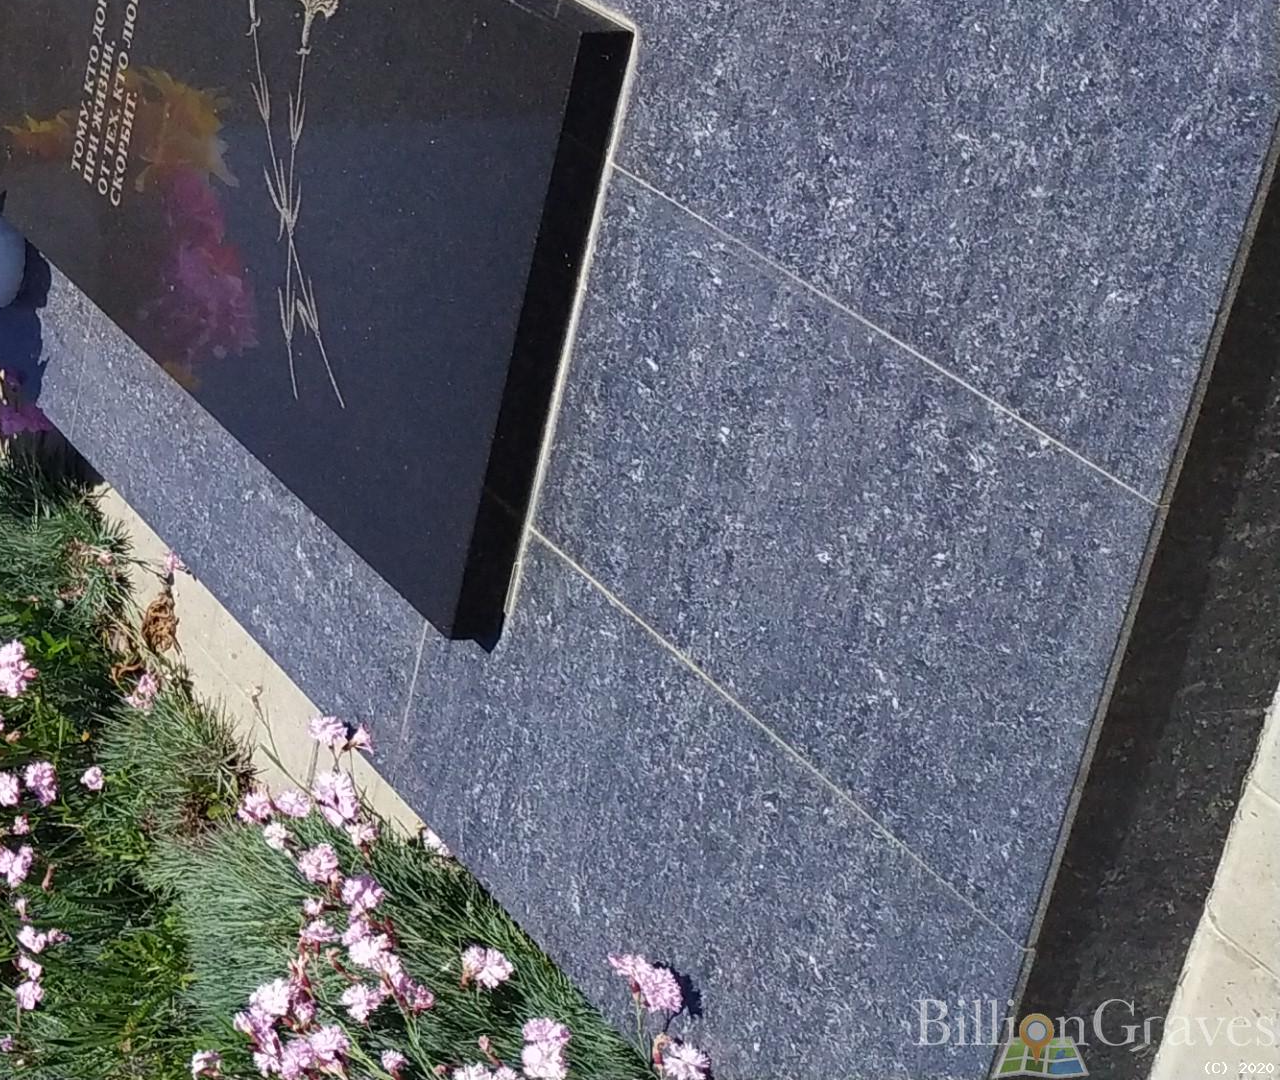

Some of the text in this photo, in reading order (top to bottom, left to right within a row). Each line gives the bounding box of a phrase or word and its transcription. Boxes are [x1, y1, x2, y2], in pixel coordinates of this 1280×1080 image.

[112, 51, 129, 101] КТО
[71, 99, 93, 171] ТОМУ,
[84, 45, 100, 94] КТО
[104, 107, 121, 156] ТЕХ,
[83, 135, 100, 184] ПРИ
[110, 92, 138, 207] СКОРБИТ.
[98, 158, 110, 196] ОТ
